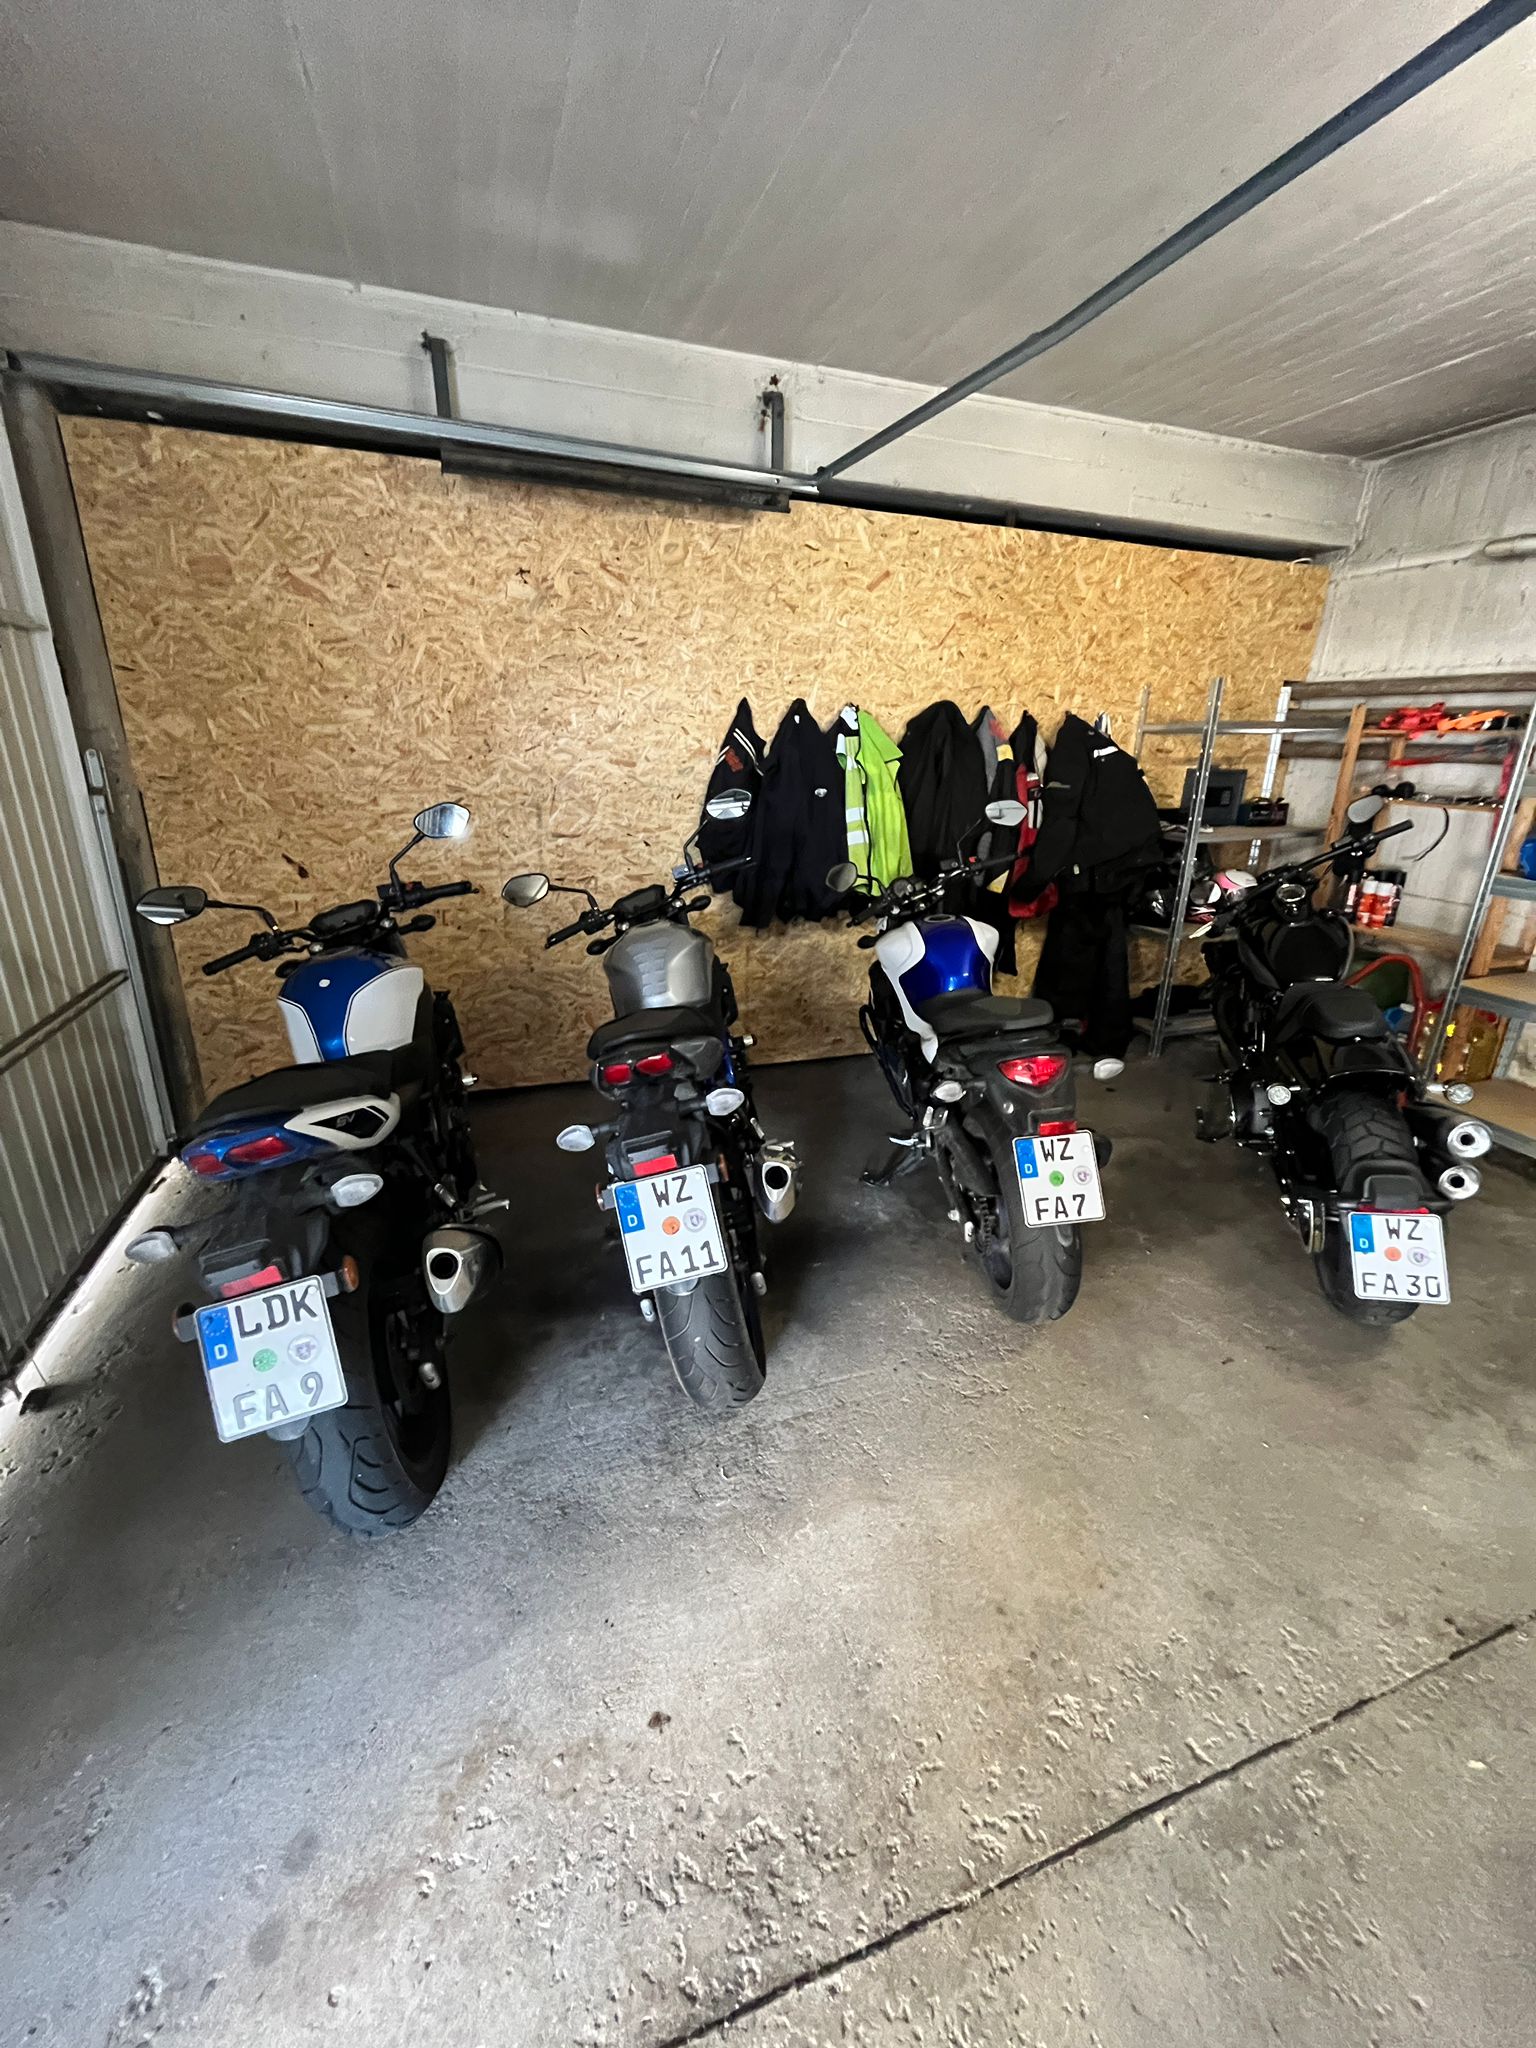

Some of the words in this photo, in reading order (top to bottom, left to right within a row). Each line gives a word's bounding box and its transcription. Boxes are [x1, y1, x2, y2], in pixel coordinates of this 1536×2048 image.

[1040, 1137, 1074, 1162] WZ
[651, 1174, 693, 1208] WZ
[627, 1214, 638, 1227] D
[1385, 1218, 1423, 1240] WZ
[1359, 1237, 1369, 1249] D
[235, 1285, 318, 1338] LDK
[214, 1343, 229, 1360] D
